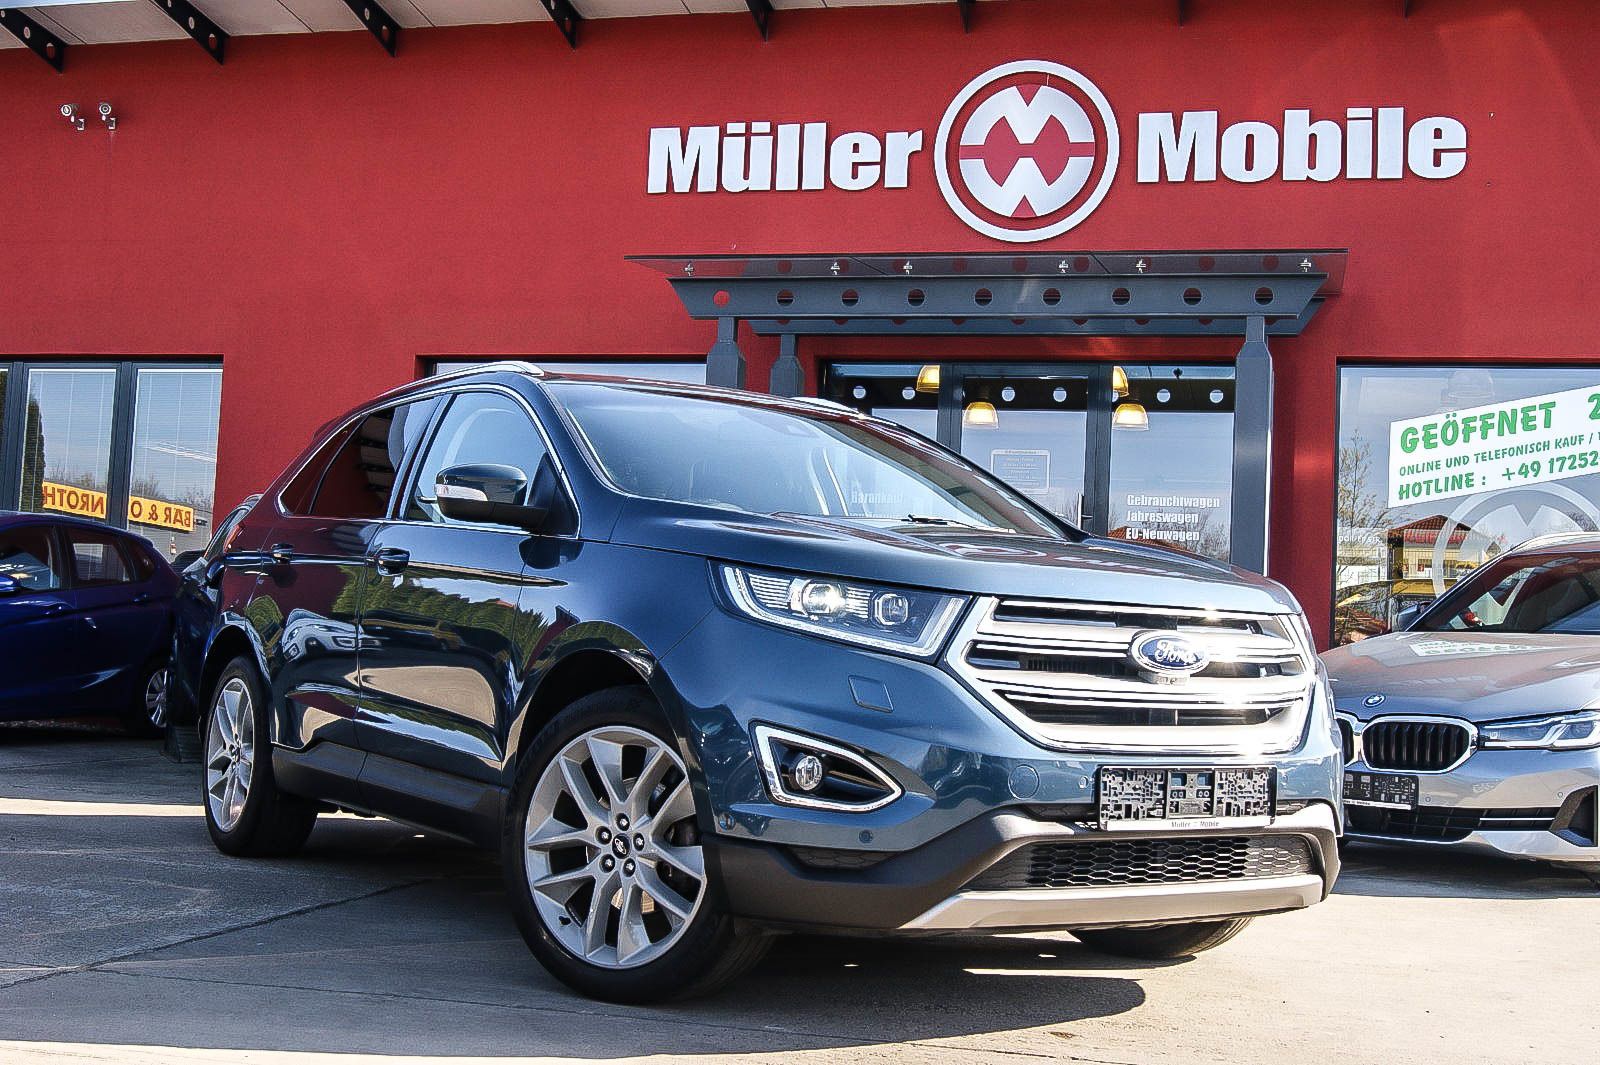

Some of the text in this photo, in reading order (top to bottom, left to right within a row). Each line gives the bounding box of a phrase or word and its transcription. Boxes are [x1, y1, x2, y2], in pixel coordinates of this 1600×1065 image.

[647, 106, 1467, 193] Müller Mobile
[1401, 401, 1556, 453] GEÖFFNET
[1398, 472, 1474, 500] HOTLINE
[1502, 460, 1541, 481] +49
[1548, 450, 1599, 474] 17252
[1400, 460, 1441, 476] ONLINE
[1446, 455, 1470, 468] UND
[1474, 440, 1550, 463] TELEFONISCH
[1555, 434, 1584, 450] KAUF
[1126, 510, 1199, 524] Jahreswagen
[1127, 494, 1220, 508] Gebrauchtwagen
[1125, 527, 1200, 542] EU-Neuwagen
